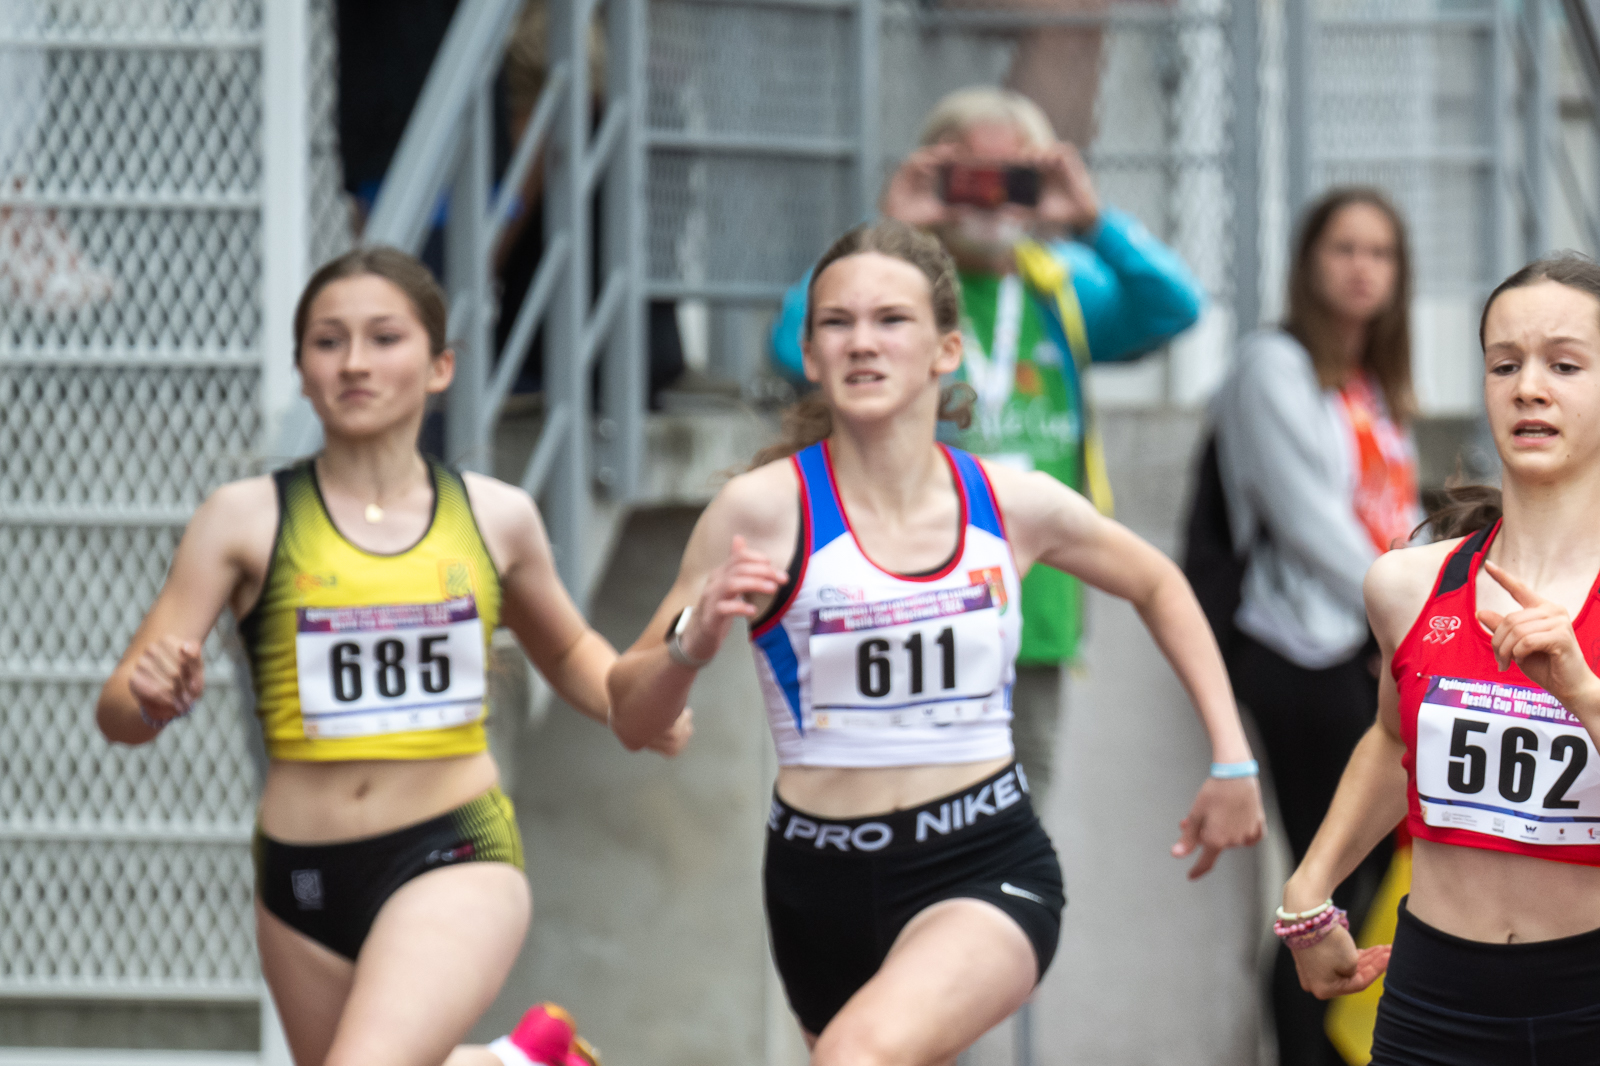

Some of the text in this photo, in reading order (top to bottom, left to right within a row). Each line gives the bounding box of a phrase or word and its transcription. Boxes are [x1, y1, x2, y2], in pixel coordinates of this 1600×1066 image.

[330, 634, 450, 702] 685
[857, 626, 956, 698] 611
[1460, 691, 1492, 708] Nestlé
[1493, 696, 1512, 713] Cup
[1447, 717, 1588, 809] 562
[783, 814, 893, 851] PRO
[915, 770, 1022, 842] NIKE
